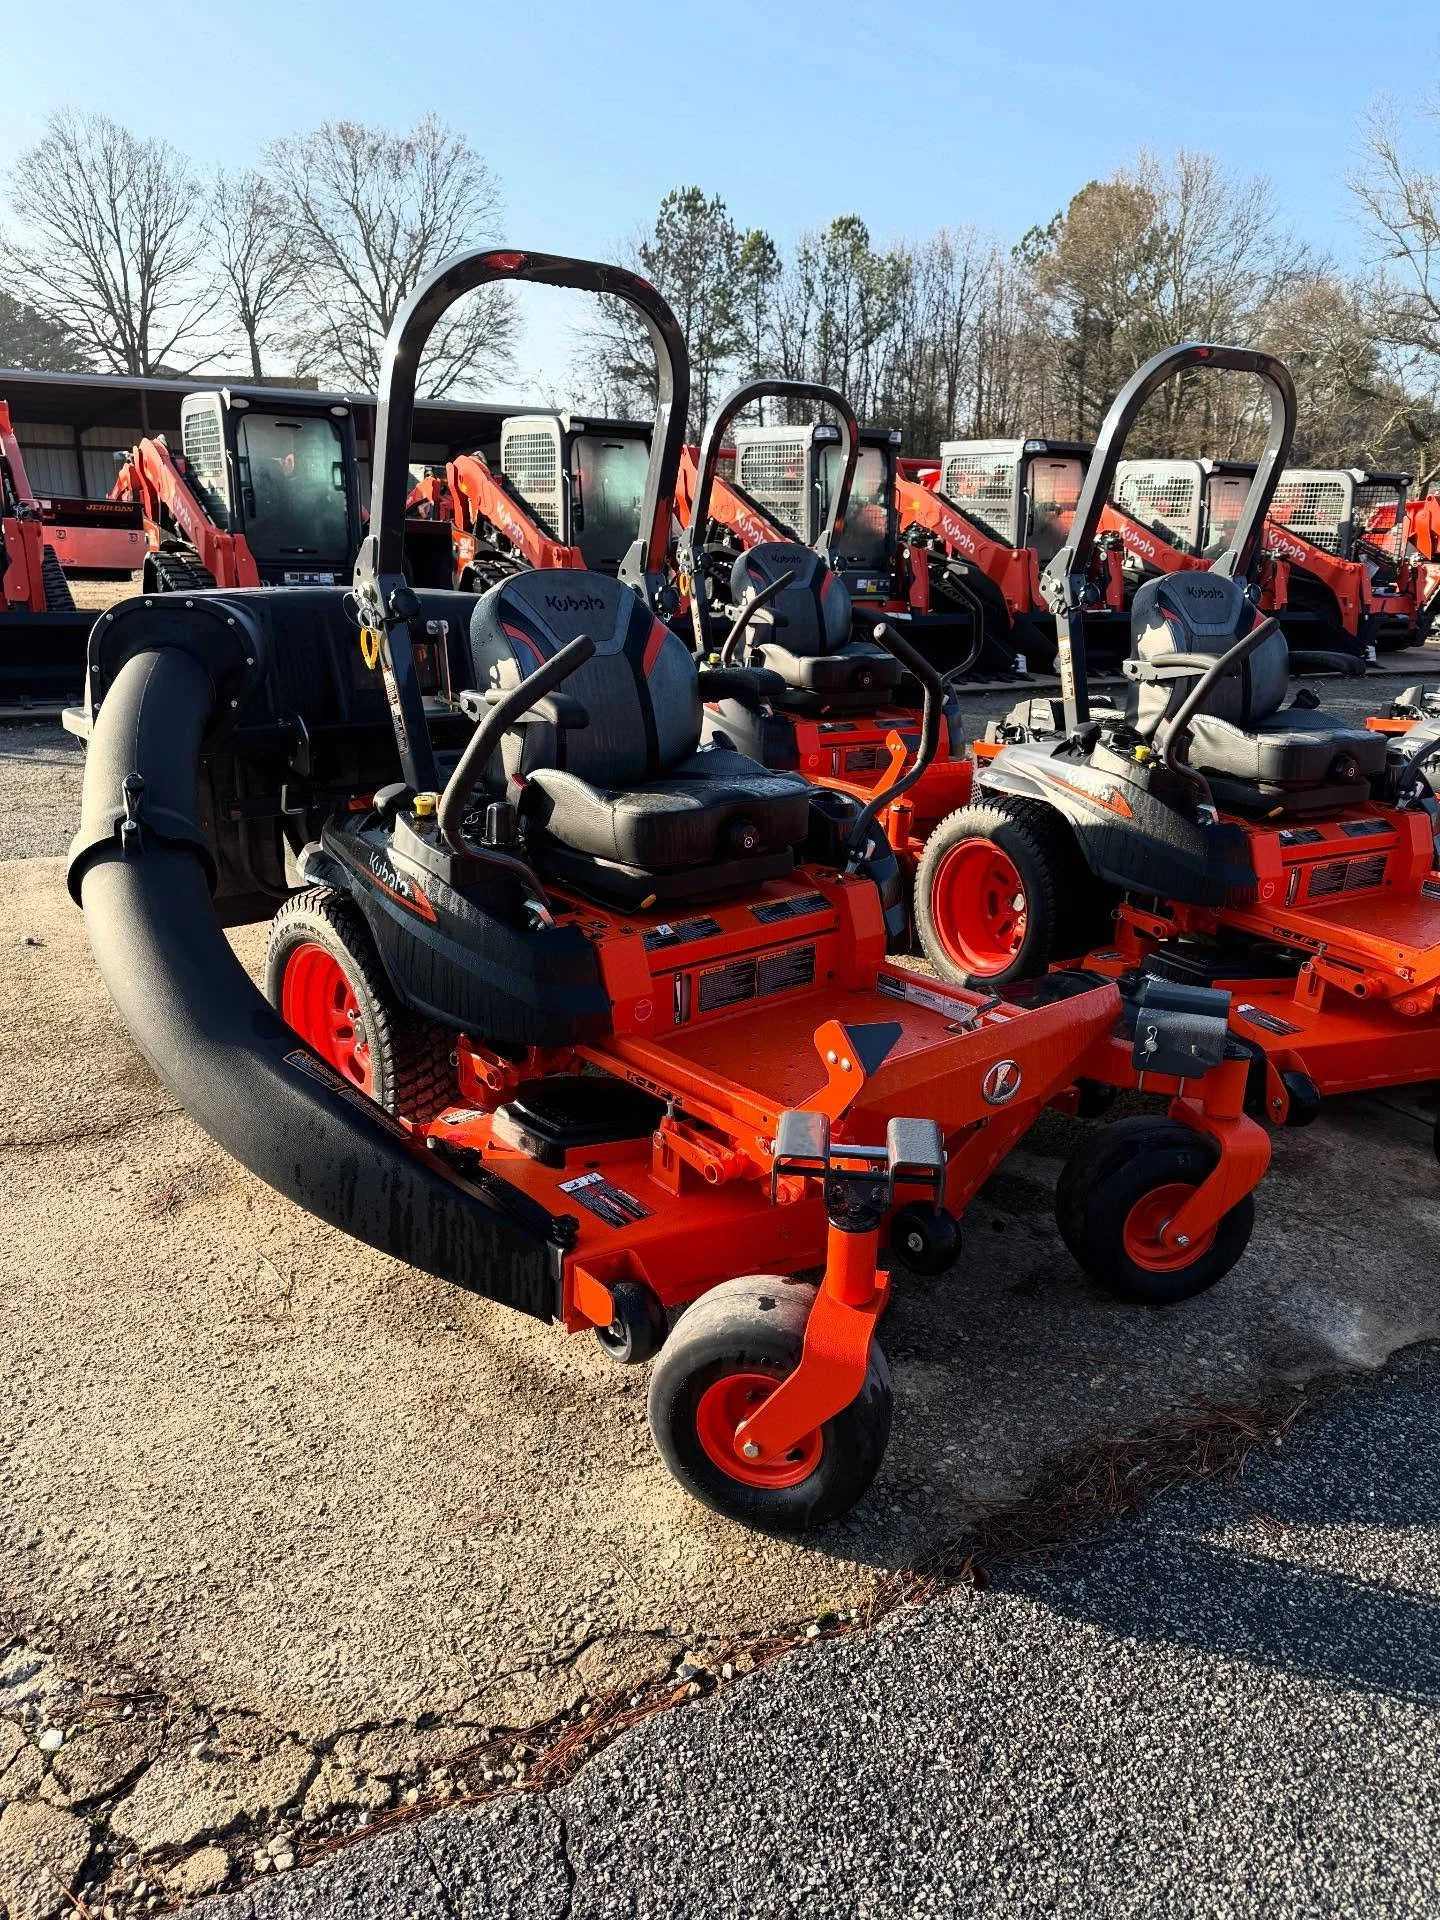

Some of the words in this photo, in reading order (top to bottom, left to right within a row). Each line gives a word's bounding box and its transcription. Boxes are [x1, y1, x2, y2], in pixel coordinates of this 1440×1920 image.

[496, 502, 525, 545] Kubota
[941, 514, 975, 554] Kubota
[1119, 524, 1155, 558] Kubota
[1268, 530, 1306, 562] Kubota
[545, 594, 606, 611] Kubota
[1185, 585, 1225, 599] Kubota
[368, 851, 409, 897] Kubota
